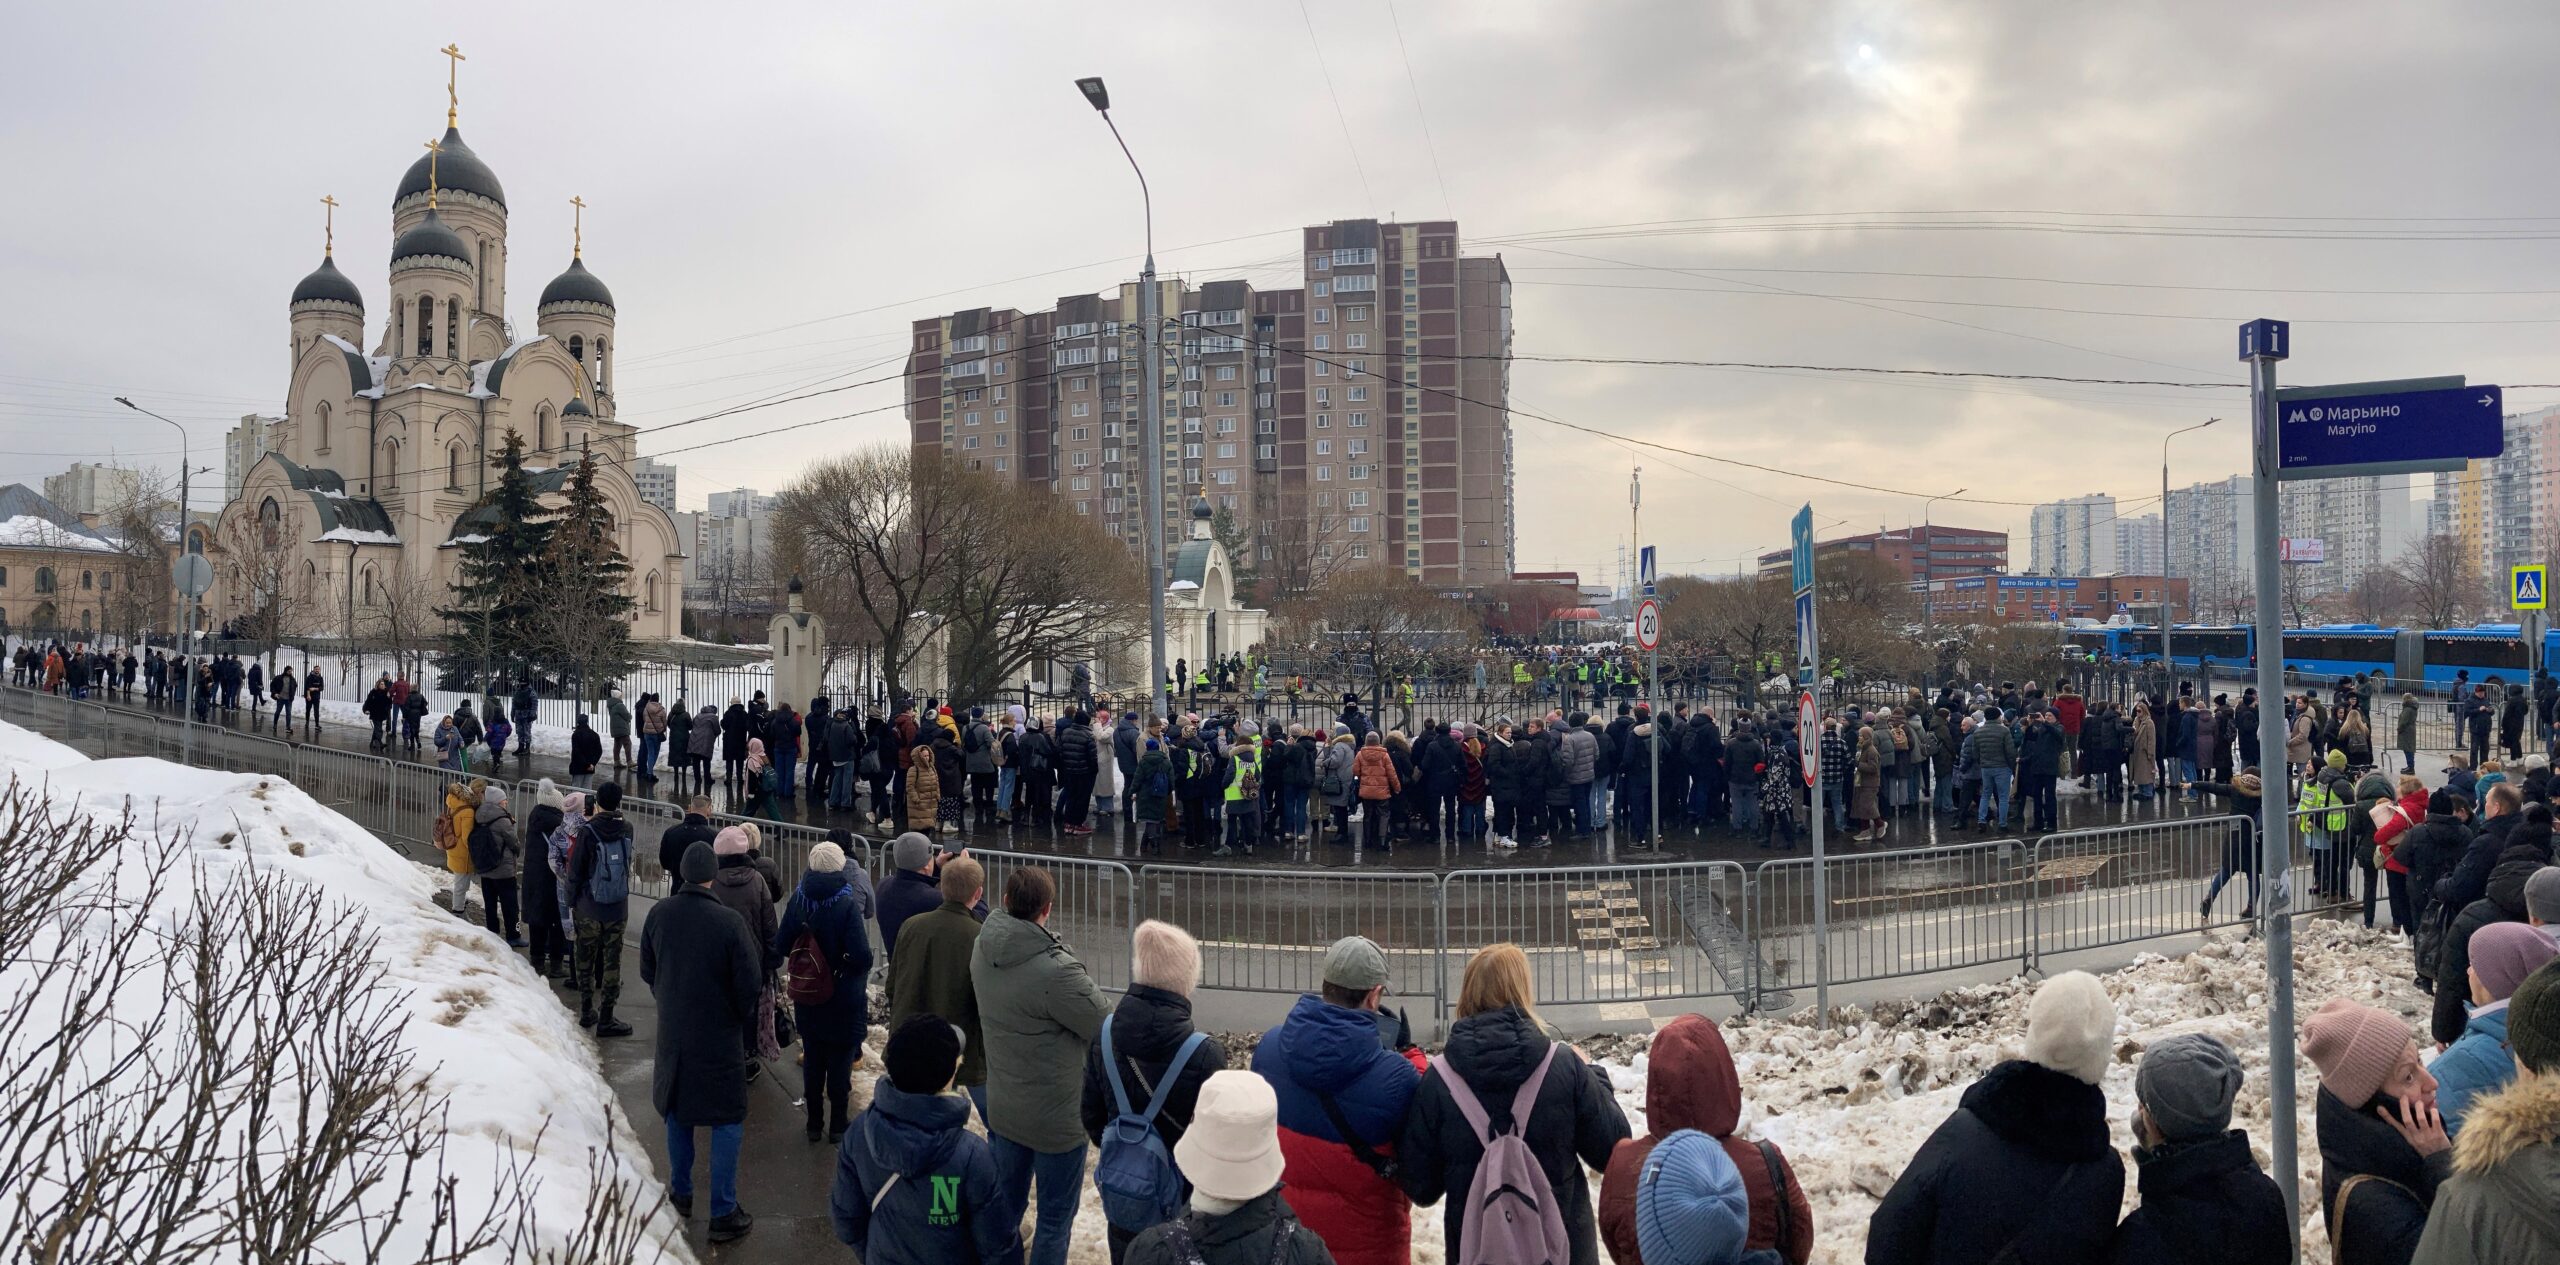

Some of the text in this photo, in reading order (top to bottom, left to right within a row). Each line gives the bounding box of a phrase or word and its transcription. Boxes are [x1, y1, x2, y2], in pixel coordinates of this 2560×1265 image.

[2327, 405, 2400, 422] Марьино
[2328, 423, 2376, 437] Maryino
[1643, 615, 1656, 635] 20
[1803, 719, 1814, 757] 20
[930, 1175, 960, 1214] N
[928, 1215, 960, 1225] NEW
